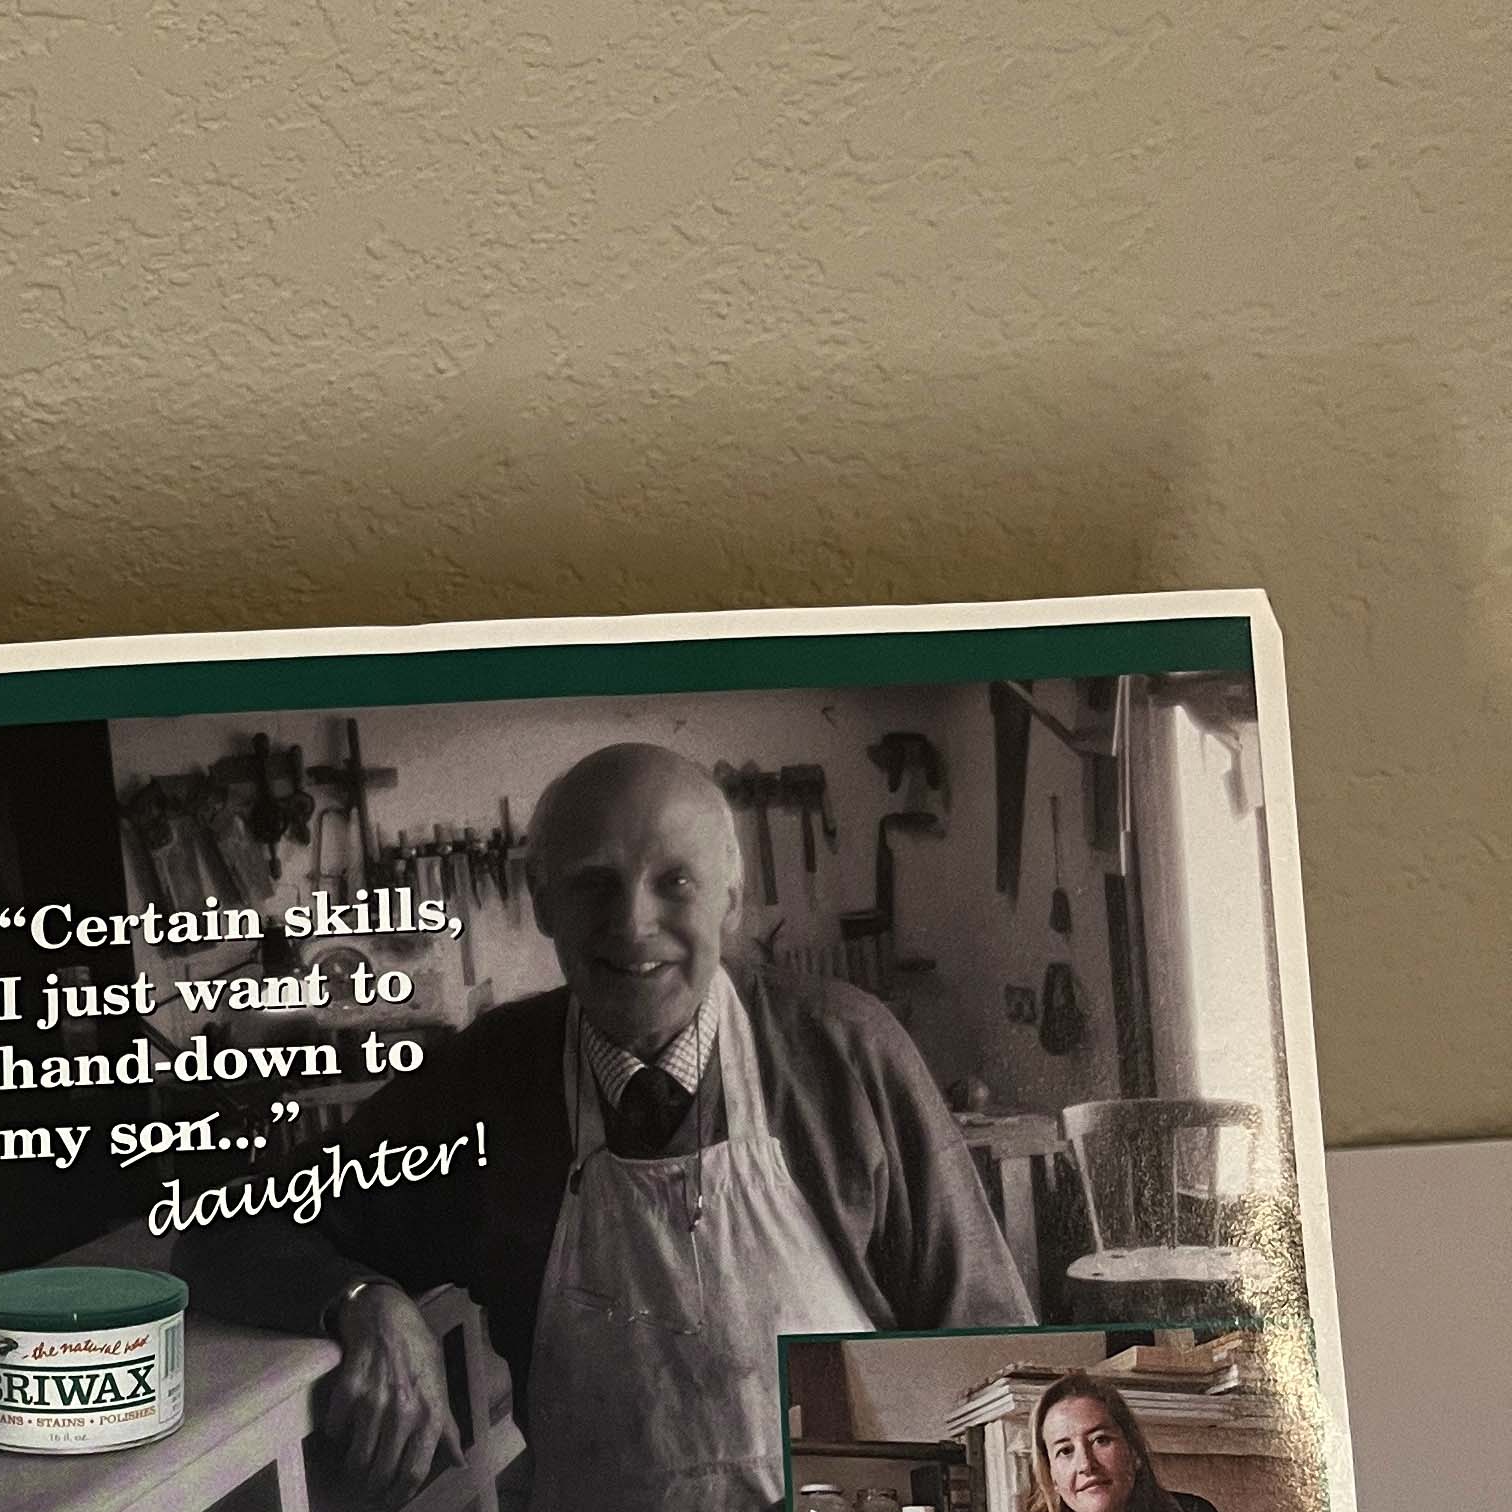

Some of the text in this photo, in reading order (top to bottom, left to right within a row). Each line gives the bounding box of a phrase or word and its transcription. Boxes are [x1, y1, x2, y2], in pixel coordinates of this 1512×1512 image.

[0, 886, 462, 949] "Certain skills,
[37, 972, 155, 1029] just
[174, 964, 328, 1012] want
[351, 962, 412, 1003] to
[362, 1032, 423, 1073] to
[0, 1127, 90, 1168] my
[145, 1116, 486, 1235] daughter!
[32, 1342, 57, 1359] the
[60, 1340, 121, 1355] natural
[37, 1407, 155, 1427] STAINS POLISHES
